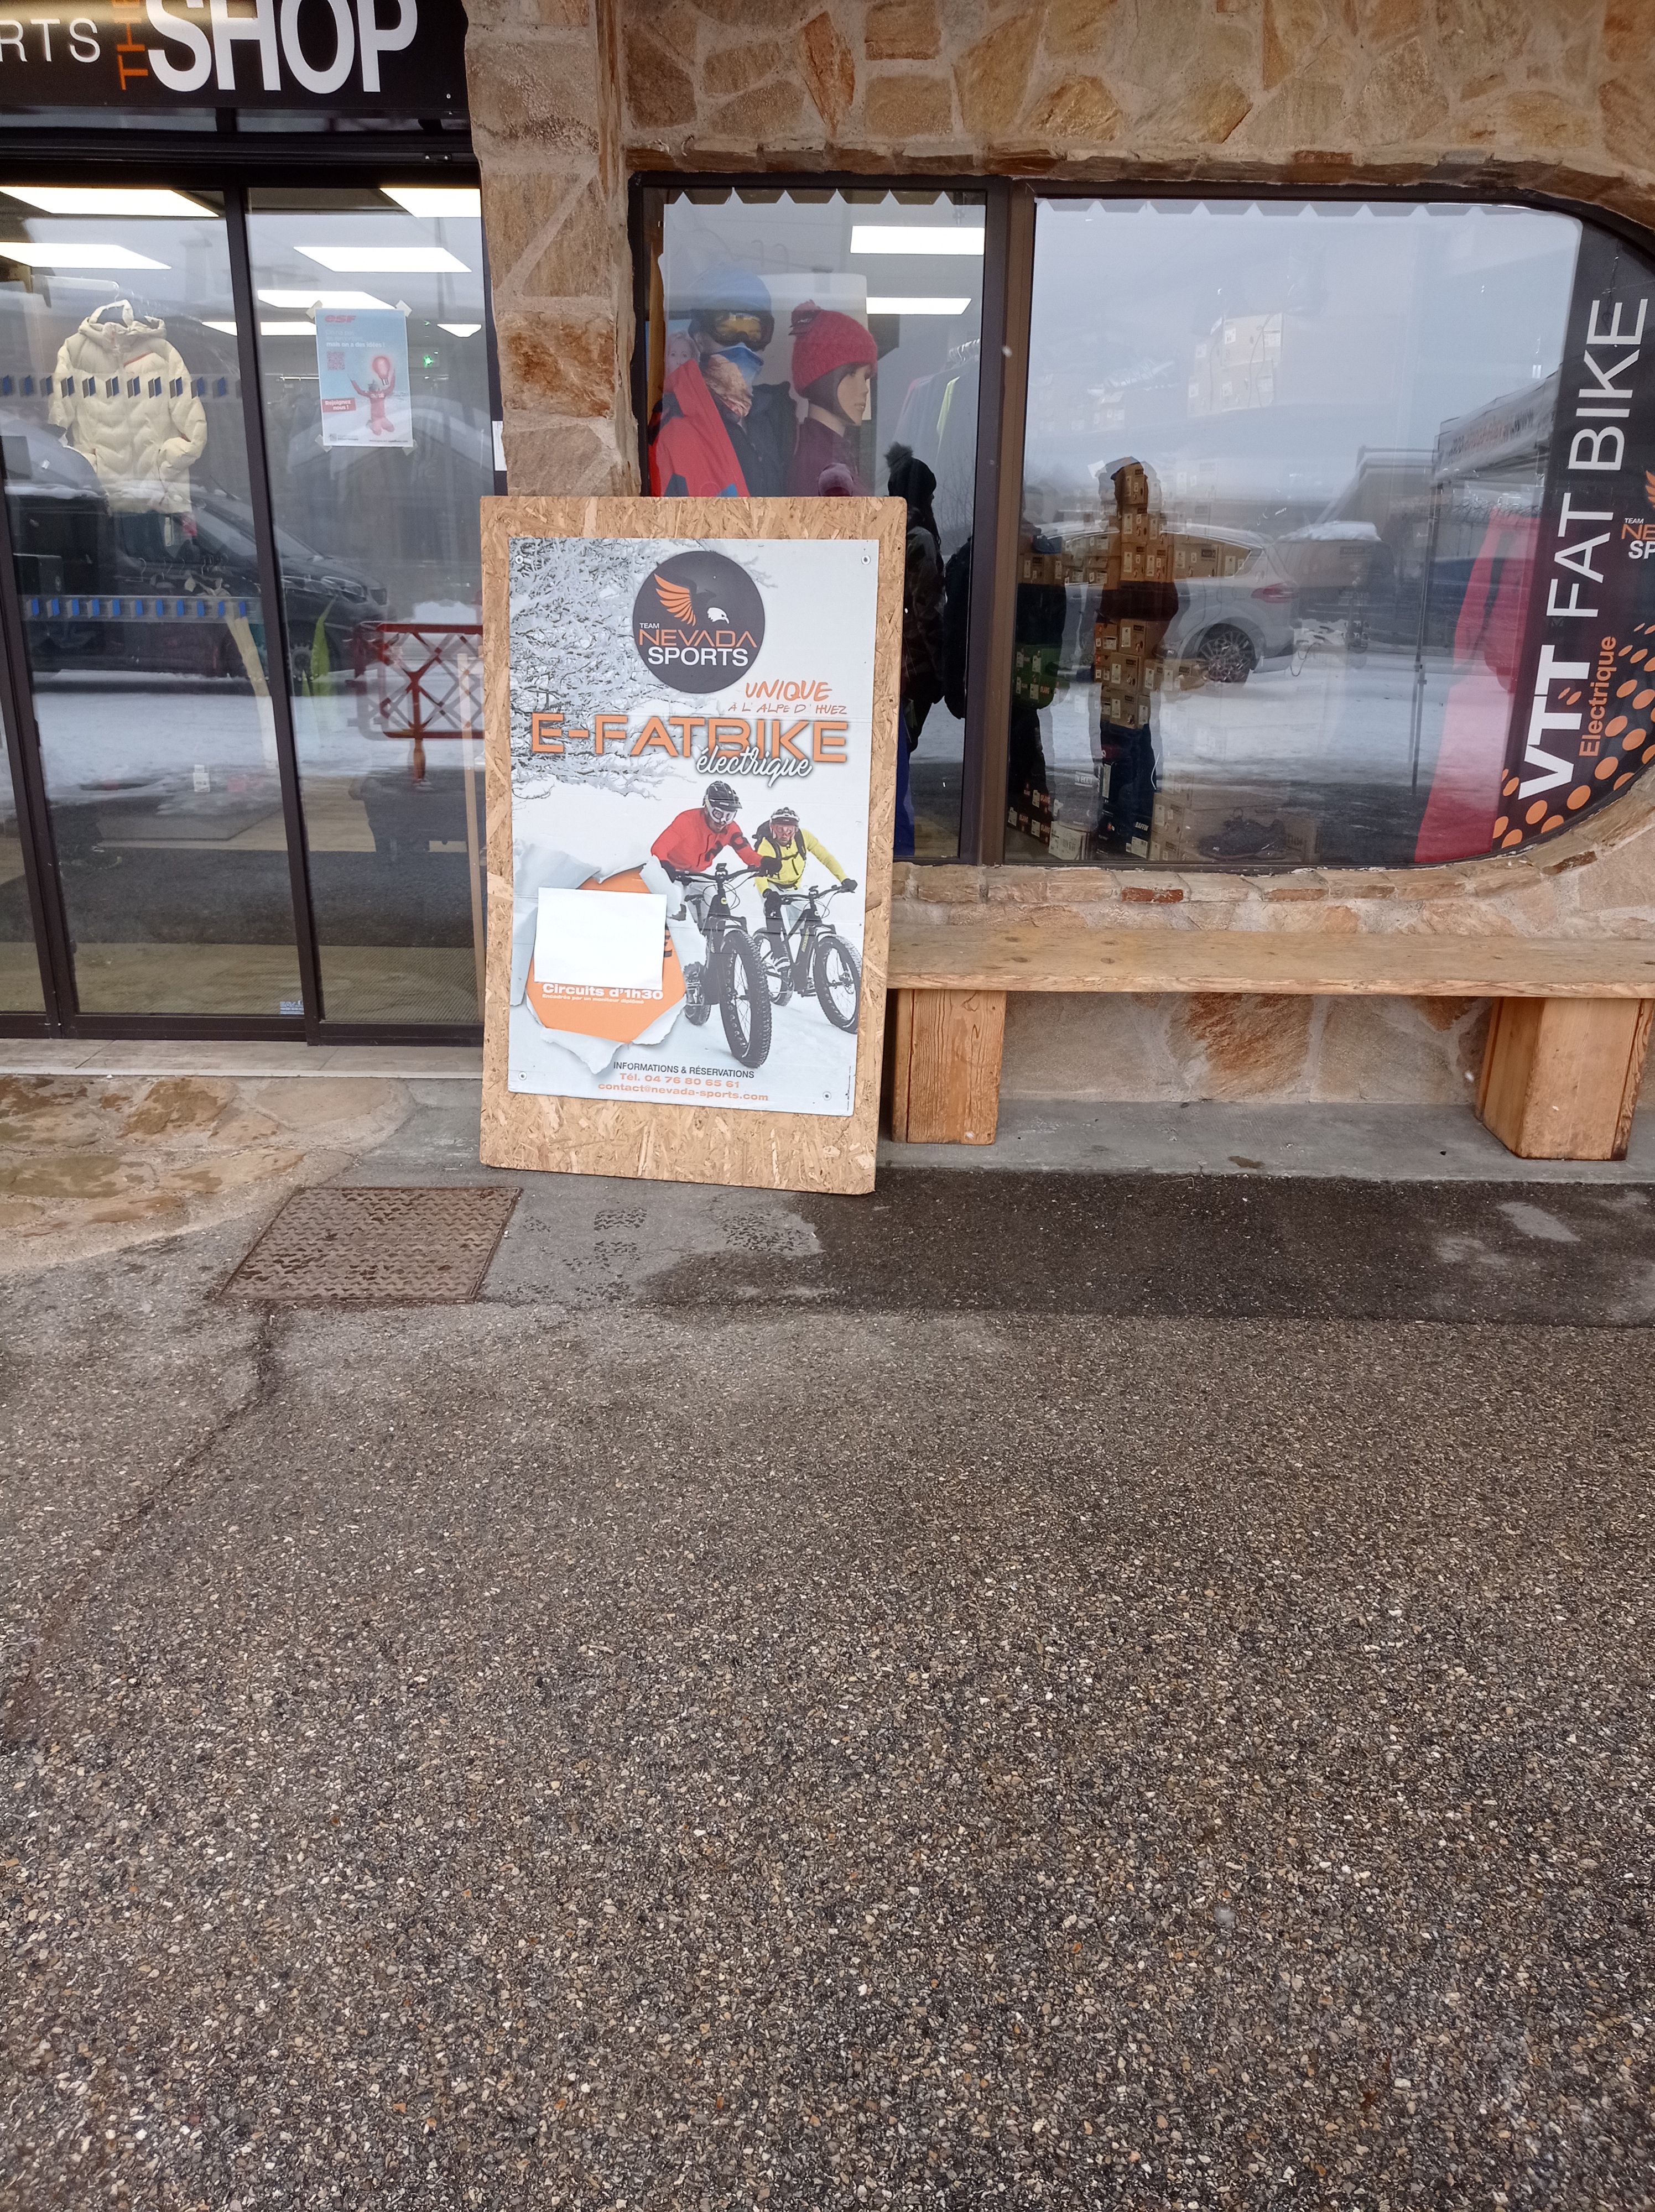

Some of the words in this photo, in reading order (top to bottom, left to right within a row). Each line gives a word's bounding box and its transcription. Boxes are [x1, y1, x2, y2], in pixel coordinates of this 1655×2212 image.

[112, 0, 148, 90] TH
[146, 0, 418, 94] SHOP
[1568, 298, 1648, 471] BIKE
[1546, 493, 1614, 617] FAT
[639, 629, 757, 648] NEVADA
[647, 646, 748, 667] SPORTS
[745, 679, 832, 702] UNIQUE
[1579, 636, 1617, 757] Electrique
[756, 703, 790, 713] ALPE
[1518, 644, 1590, 800] VTT
[530, 712, 849, 763] E-FATBIKE
[696, 745, 813, 787] électrique
[543, 983, 605, 997] Circuits
[613, 1062, 679, 1073] INFORMATIONS
[689, 1065, 754, 1078] RÉSERVATIONS
[620, 1073, 641, 1081] Tél.
[645, 1074, 662, 1083] 04
[705, 1079, 721, 1087] 65
[598, 1083, 768, 1101] contact@nevada-sports.com
